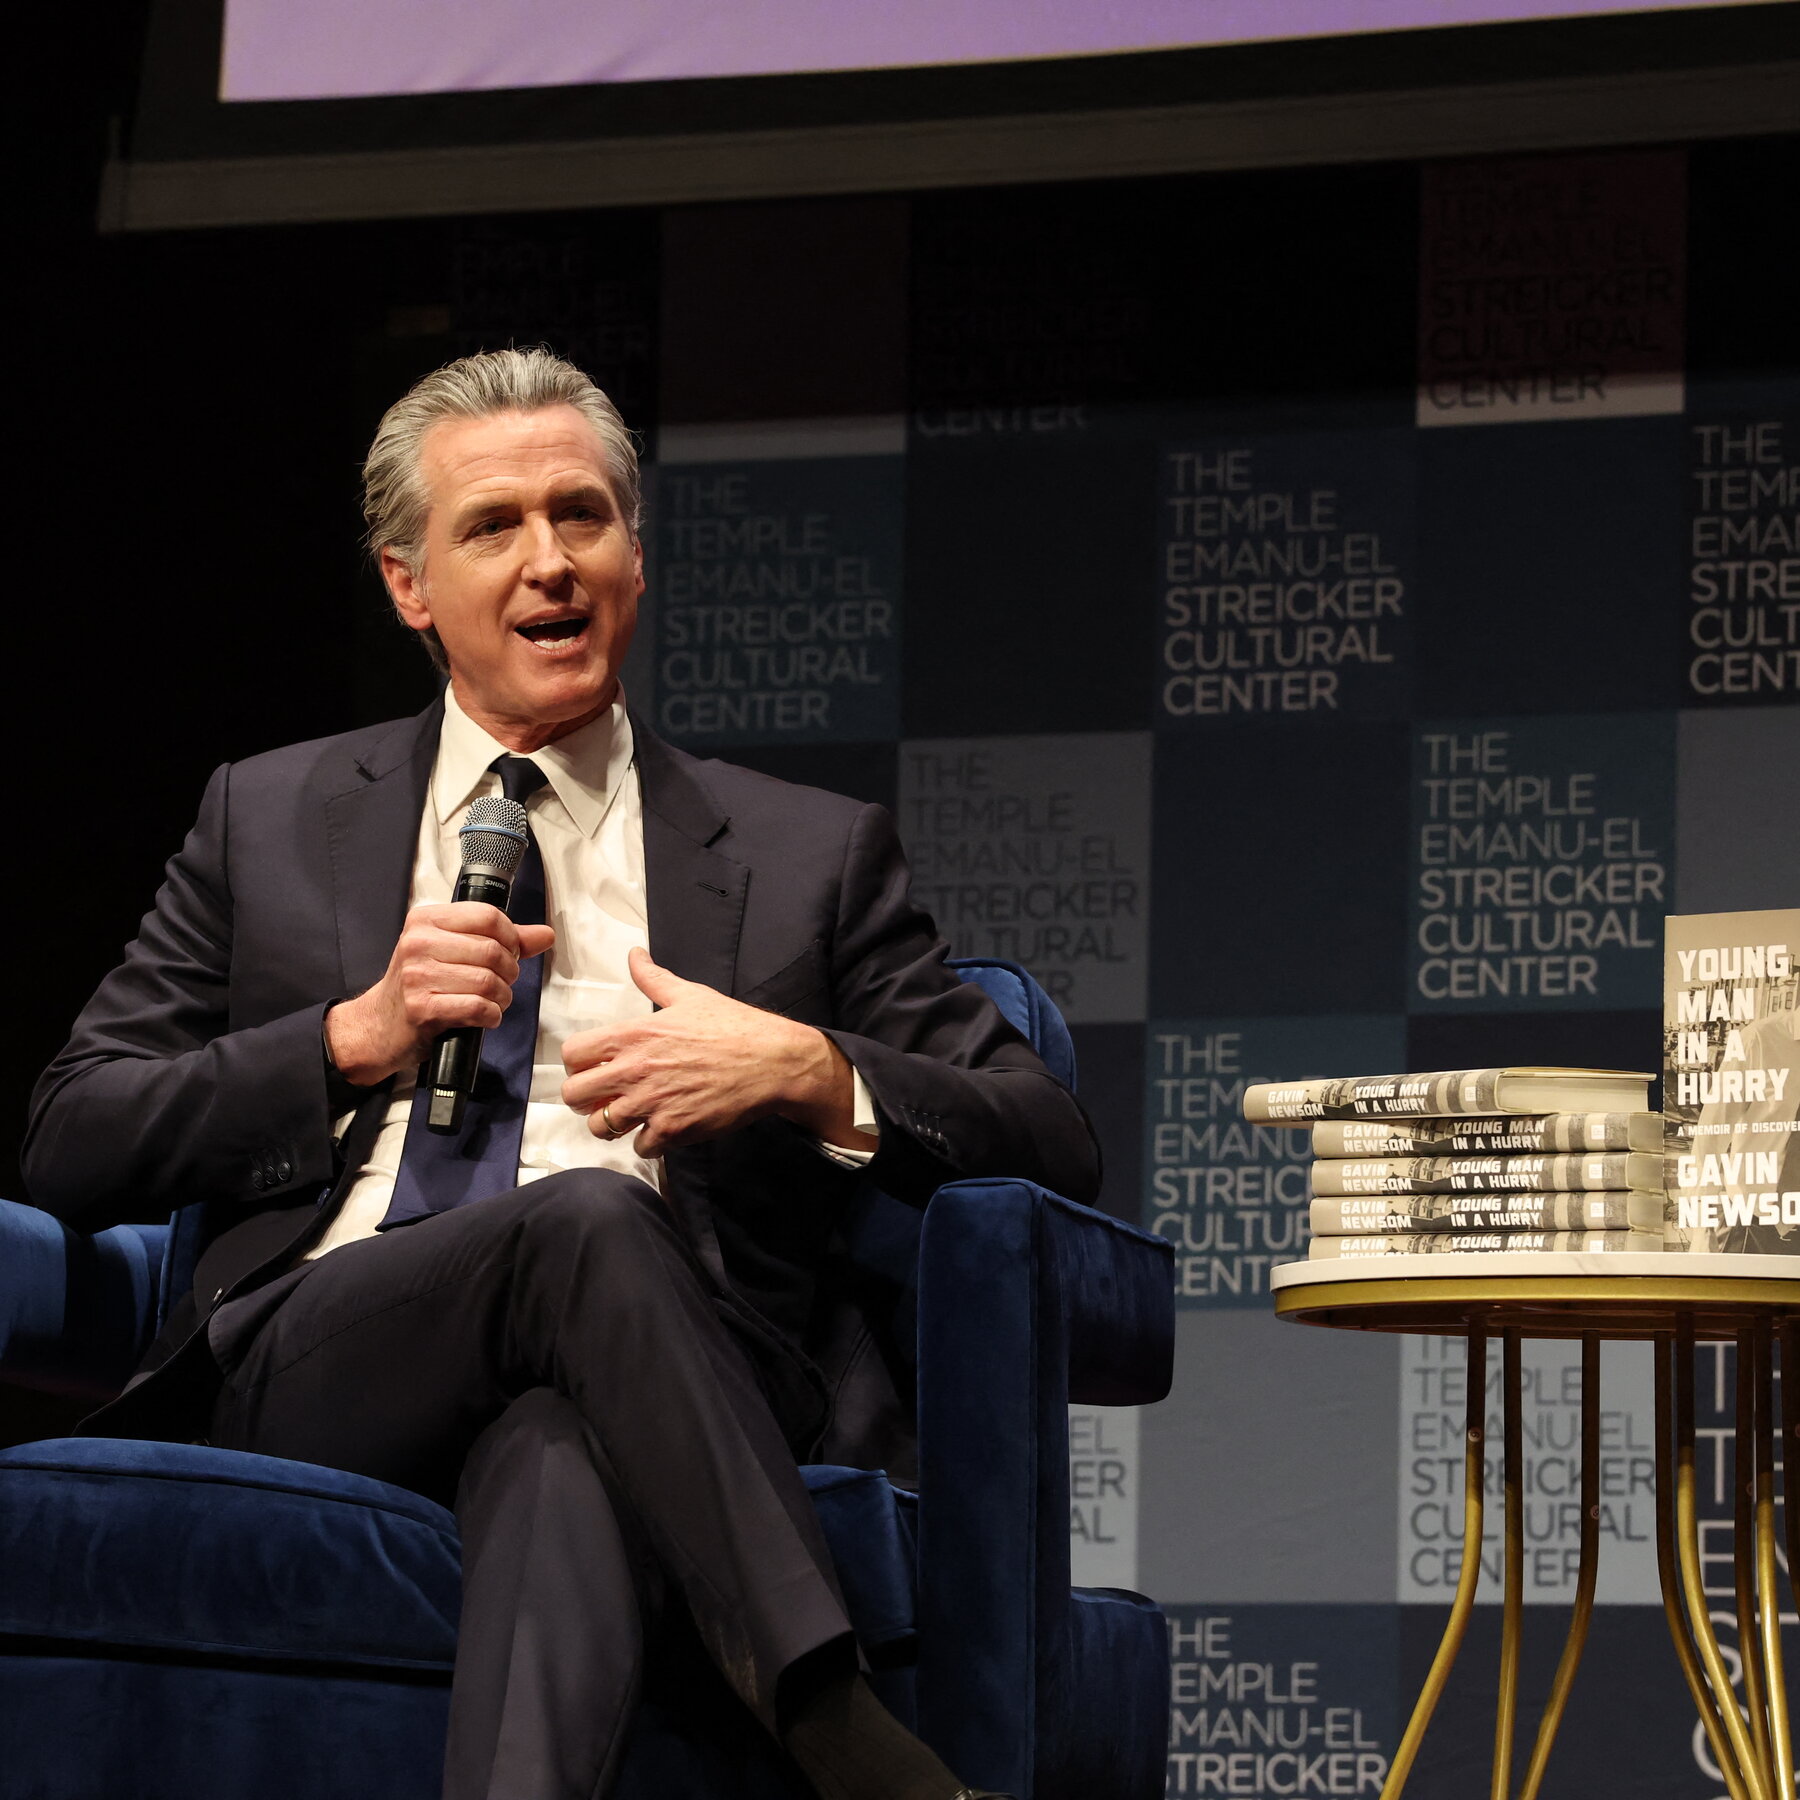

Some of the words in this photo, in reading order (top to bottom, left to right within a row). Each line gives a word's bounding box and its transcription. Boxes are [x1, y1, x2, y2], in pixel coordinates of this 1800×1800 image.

[1431, 266, 1674, 320] STREICKER
[1428, 316, 1662, 364] CULTURAL
[1428, 362, 1607, 409] CENTER
[914, 395, 1089, 437] CENTER
[1693, 421, 1784, 465] THE
[1167, 449, 1254, 493] THE
[666, 473, 751, 517] THE
[1167, 489, 1339, 537] TEMPLE
[666, 512, 831, 559] TEMPLE
[1691, 513, 1800, 558] EMA
[664, 555, 884, 603] EMANU-EL
[1165, 532, 1397, 583] EMANU-EL
[664, 599, 894, 647] STREICKER
[1164, 577, 1405, 627] STREICKER
[661, 645, 882, 691] CULTURAL
[1163, 623, 1395, 671] CULTURAL
[660, 689, 832, 735] CENTER
[1162, 669, 1340, 716] CENTER
[909, 752, 991, 791] THE
[1420, 731, 1511, 775] THE
[909, 792, 1073, 836] TEMPLE
[1420, 773, 1597, 820] TEMPLE
[1420, 817, 1658, 866] EMANU-EL
[1419, 862, 1666, 910] STREICKER
[1417, 908, 1656, 955] CULTURAL
[1417, 954, 1599, 999] CENTER
[1677, 944, 1789, 982] YOUNG
[1677, 987, 1755, 1024] MAN
[1154, 1033, 1243, 1075] THE
[1677, 1030, 1708, 1065] IN
[1722, 1029, 1747, 1062] A
[1267, 1089, 1306, 1104] GAVIN
[1355, 1085, 1395, 1099] YOUNG
[1400, 1082, 1430, 1096] MAN
[1355, 1100, 1369, 1114] IN
[1373, 1099, 1382, 1113] A
[1386, 1098, 1427, 1112] HURRY
[1677, 1068, 1790, 1106] HURRY
[1267, 1103, 1325, 1118] NEWSOM
[1343, 1125, 1388, 1138] GAVIN
[1453, 1121, 1503, 1135] YOUNG
[1509, 1119, 1545, 1133] MAN
[1677, 1125, 1685, 1137] A
[1688, 1123, 1731, 1136] MEMOIR
[1735, 1122, 1748, 1134] OF
[1154, 1121, 1313, 1165] EMANU
[1343, 1139, 1414, 1152] NEWSOM
[1452, 1136, 1469, 1150] IN
[1475, 1136, 1486, 1150] A
[1491, 1135, 1542, 1149] HURRY
[1153, 1164, 1314, 1208] STREIC
[1342, 1163, 1387, 1177] GAVIN
[1342, 1178, 1413, 1192] NEWSOM
[1450, 1175, 1467, 1189] IN
[1473, 1175, 1484, 1189] A
[1489, 1174, 1540, 1188] HURRY
[1451, 1160, 1502, 1174] YOUNG
[1507, 1159, 1544, 1173] MAN
[1677, 1151, 1778, 1188] GAVIN
[1340, 1201, 1386, 1215] GAVIN
[1341, 1215, 1413, 1230] NEWSOM
[1450, 1213, 1468, 1227] IN
[1473, 1213, 1485, 1226] A
[1489, 1212, 1541, 1226] HURRY
[1451, 1198, 1502, 1212] YOUNG
[1507, 1197, 1545, 1211] MAN
[1340, 1238, 1387, 1251] GAVIN
[1451, 1235, 1502, 1249] YOUNG
[1507, 1234, 1545, 1248] MAN
[1174, 1254, 1309, 1298] ENT
[1165, 1616, 1232, 1659] HE
[1170, 1661, 1319, 1704] EMPLE
[1167, 1707, 1381, 1750] MANU-EL
[1165, 1752, 1388, 1794] TREICKER
